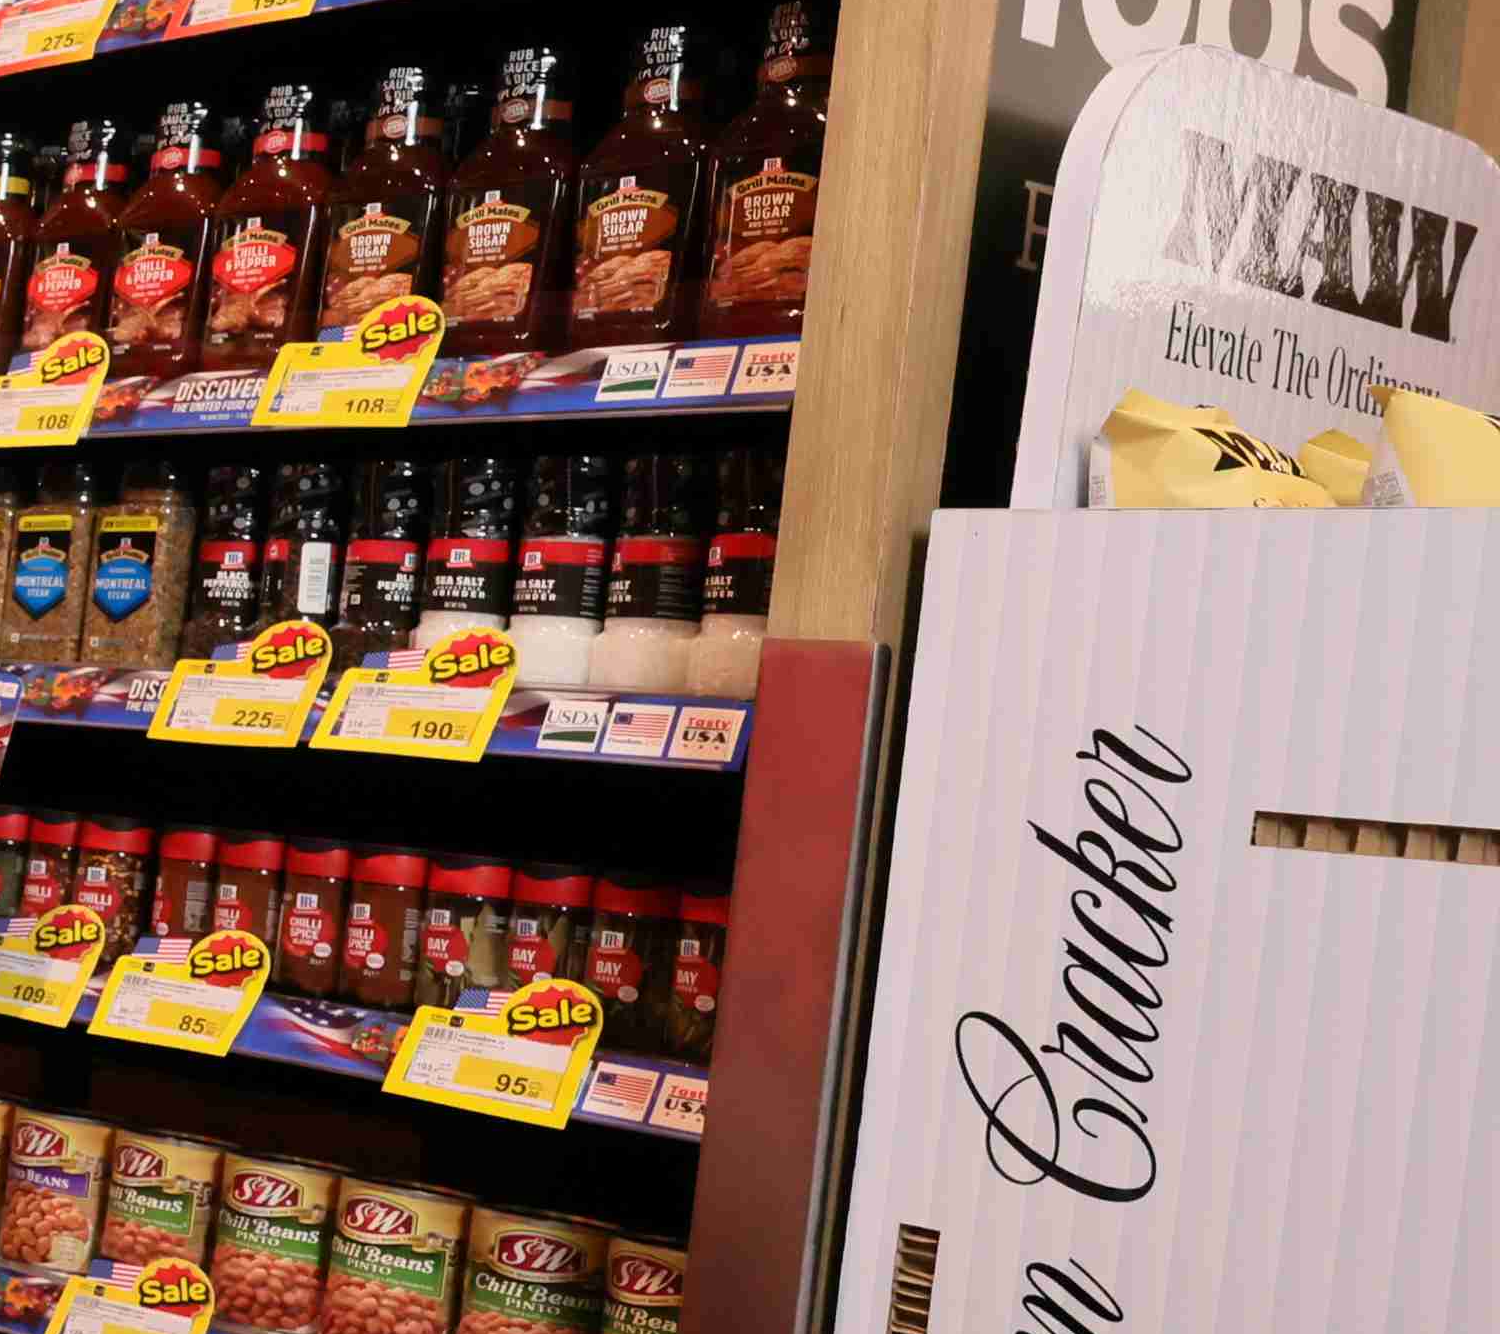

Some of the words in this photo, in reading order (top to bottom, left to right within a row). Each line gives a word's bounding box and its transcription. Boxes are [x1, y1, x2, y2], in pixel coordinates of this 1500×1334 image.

[40, 32, 75, 53] 275
[509, 49, 535, 63] RUB
[765, 176, 806, 189] Mates
[743, 192, 795, 209] BROWN
[602, 209, 648, 226] BROWN
[744, 205, 790, 220] SUGAR
[602, 221, 644, 238] SUGAR
[1160, 128, 1479, 345] MAW
[350, 234, 392, 248] BROWN
[233, 244, 269, 259] CHILLI
[351, 244, 387, 258] SUGAR
[362, 308, 439, 349] Sale
[1164, 296, 1265, 386] Elevate
[1271, 327, 1325, 397] The
[42, 346, 103, 383] Sale
[751, 351, 796, 363] Tasty
[605, 361, 660, 376] USDA
[745, 364, 791, 378] USA
[345, 397, 384, 414] 108
[35, 413, 68, 432] 108
[251, 636, 327, 674] Sale
[430, 642, 516, 683] Sale
[231, 709, 273, 728] 225
[547, 708, 601, 727] USDA
[682, 716, 732, 732] Tasty
[409, 719, 453, 740] 190
[681, 728, 728, 745] USA
[289, 917, 323, 935] CHILLI
[426, 936, 450, 954] BAY
[511, 947, 536, 964] BAY
[954, 724, 1194, 1206] Cracker
[11, 984, 46, 1005] 109
[179, 1014, 206, 1035] 85
[508, 1000, 594, 1035] Sale
[494, 1072, 528, 1097] 95
[140, 1278, 207, 1308] Sale
[475, 1272, 524, 1300] Chili
[505, 1296, 561, 1316] PINTO
